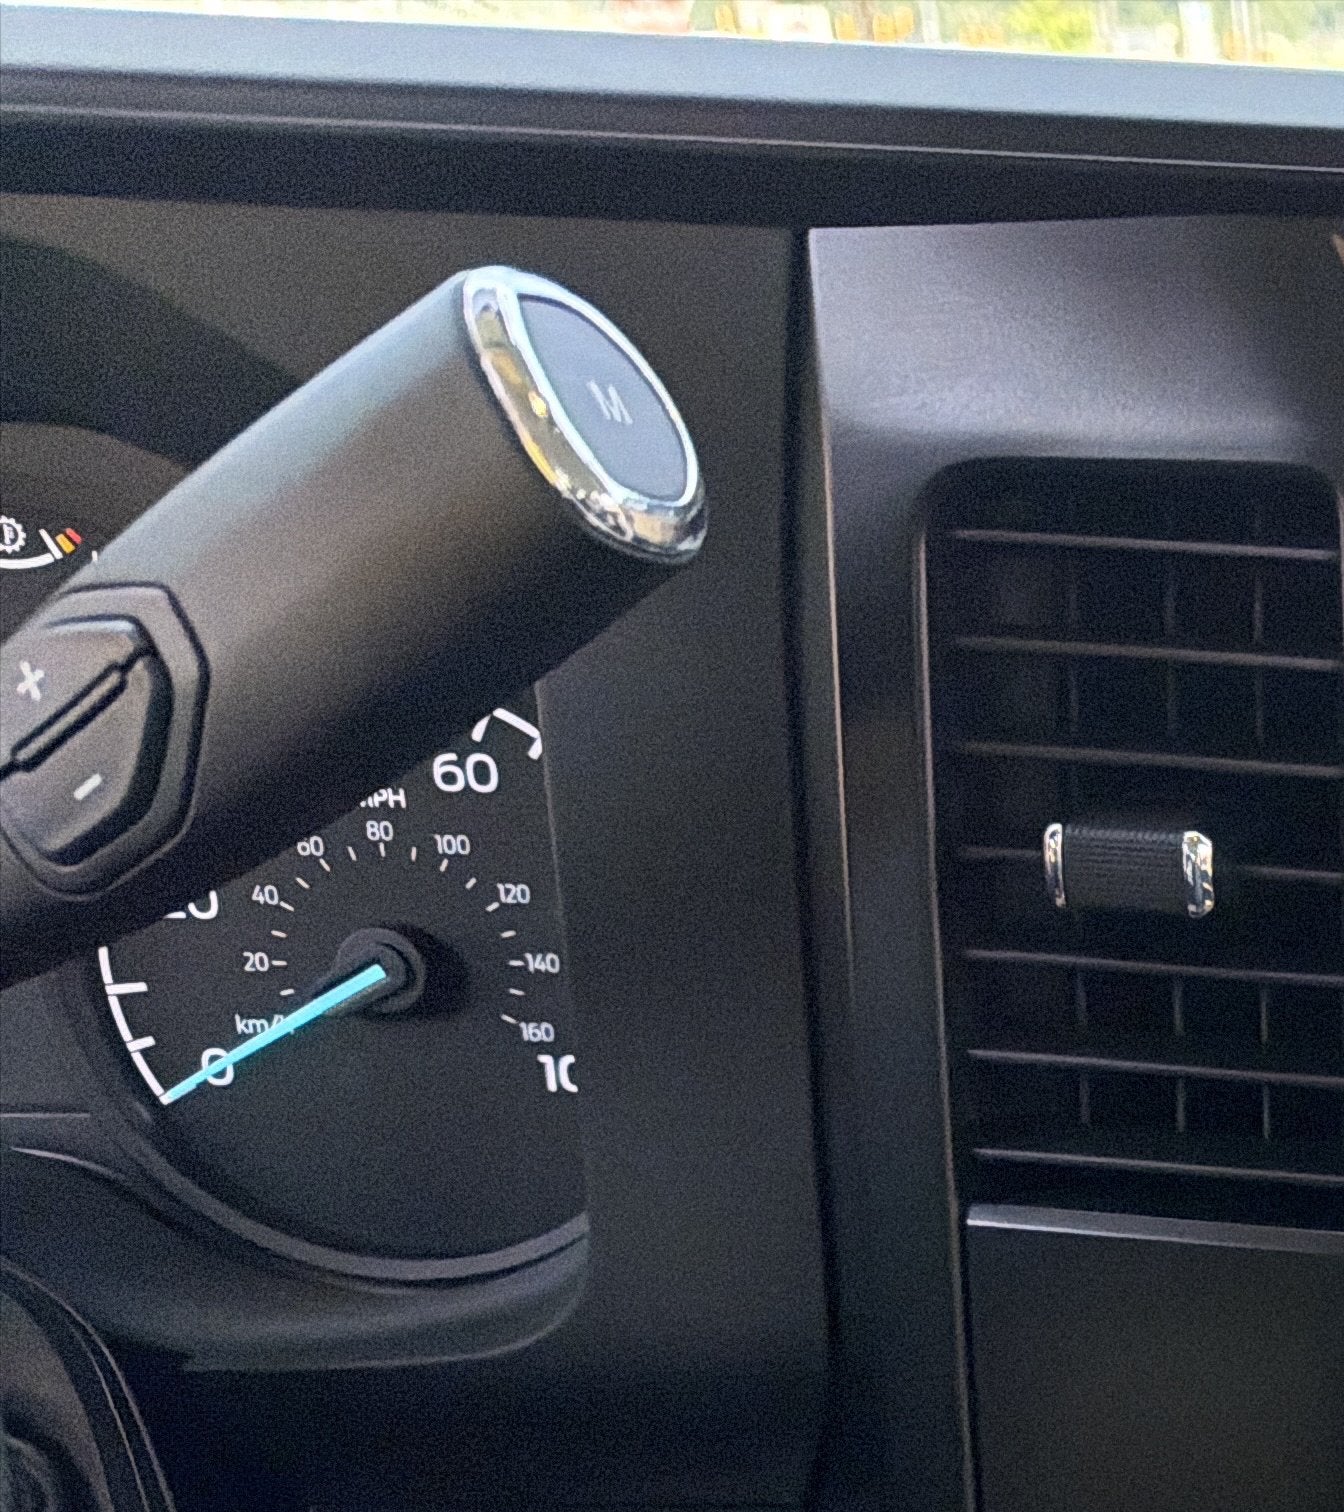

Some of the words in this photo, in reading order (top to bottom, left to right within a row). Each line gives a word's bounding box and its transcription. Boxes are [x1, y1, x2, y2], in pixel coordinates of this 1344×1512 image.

[432, 752, 499, 793] 60
[366, 820, 394, 841] 80
[297, 836, 324, 857] 60
[434, 834, 470, 856] 100
[252, 884, 279, 905] 40
[497, 883, 531, 904] 120
[243, 952, 269, 972] 20
[525, 952, 560, 974] 140
[519, 1022, 555, 1042] 160
